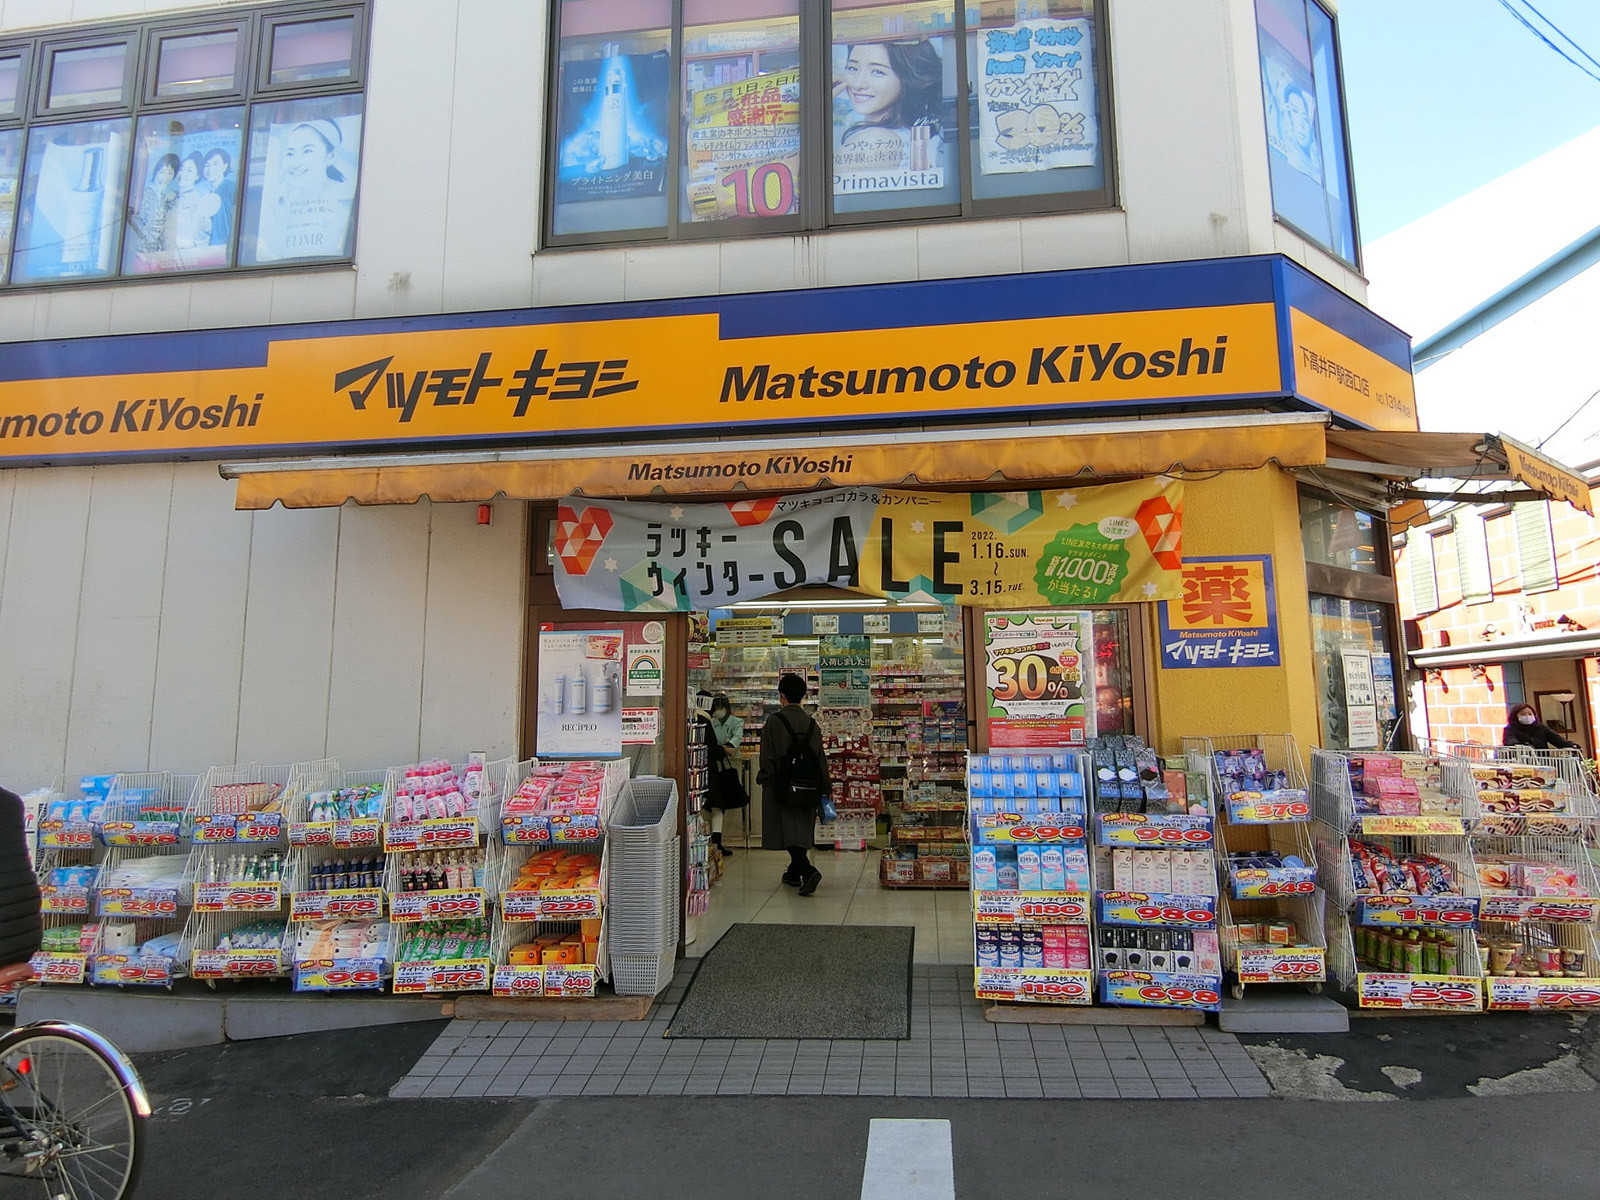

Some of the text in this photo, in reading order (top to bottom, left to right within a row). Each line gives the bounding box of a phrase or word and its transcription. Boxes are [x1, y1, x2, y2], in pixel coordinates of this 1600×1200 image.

[572, 170, 653, 186] ブライトニング美白
[722, 163, 794, 217] 10
[719, 335, 1229, 403] Matsumoto KiYoshi
[333, 349, 640, 423] マツモトキヨシ
[109, 392, 265, 433] KiYoshi
[628, 454, 854, 482] Matsumoto KiYoshi
[647, 524, 738, 558] ラッキー
[772, 515, 964, 595] SALE
[1182, 565, 1254, 625] 薬
[1179, 629, 1259, 639] Matsumoto KiYoshi
[1165, 638, 1275, 665] マツモトキヨシ
[1254, 803, 1309, 818] 378
[55, 833, 93, 844] 118
[204, 826, 237, 840] 278
[247, 824, 280, 838] 378
[305, 832, 333, 845] 398
[350, 829, 377, 842] 398
[515, 828, 550, 841] 268
[564, 827, 600, 840] 238
[1010, 825, 1085, 840] 698
[1134, 827, 1212, 843] 980
[124, 833, 177, 845] 178
[1258, 881, 1315, 896] 448
[50, 898, 87, 909] 118
[228, 891, 276, 905] 98
[122, 900, 177, 913] 248
[328, 899, 378, 914] 178
[427, 899, 480, 914] 198
[541, 900, 597, 914] 228
[1021, 902, 1083, 917] 1180
[1134, 905, 1215, 923] 980
[1396, 908, 1474, 923] 118
[47, 964, 82, 976] 278
[117, 966, 169, 981] 95
[227, 959, 277, 973] 178
[1271, 961, 1323, 976] 478
[323, 970, 379, 985] 98
[432, 969, 485, 984] 178
[512, 977, 541, 991] 498
[562, 976, 593, 990] 448
[1022, 980, 1085, 996] 1180
[1139, 985, 1220, 1004] 698
[1409, 986, 1476, 1003] 59
